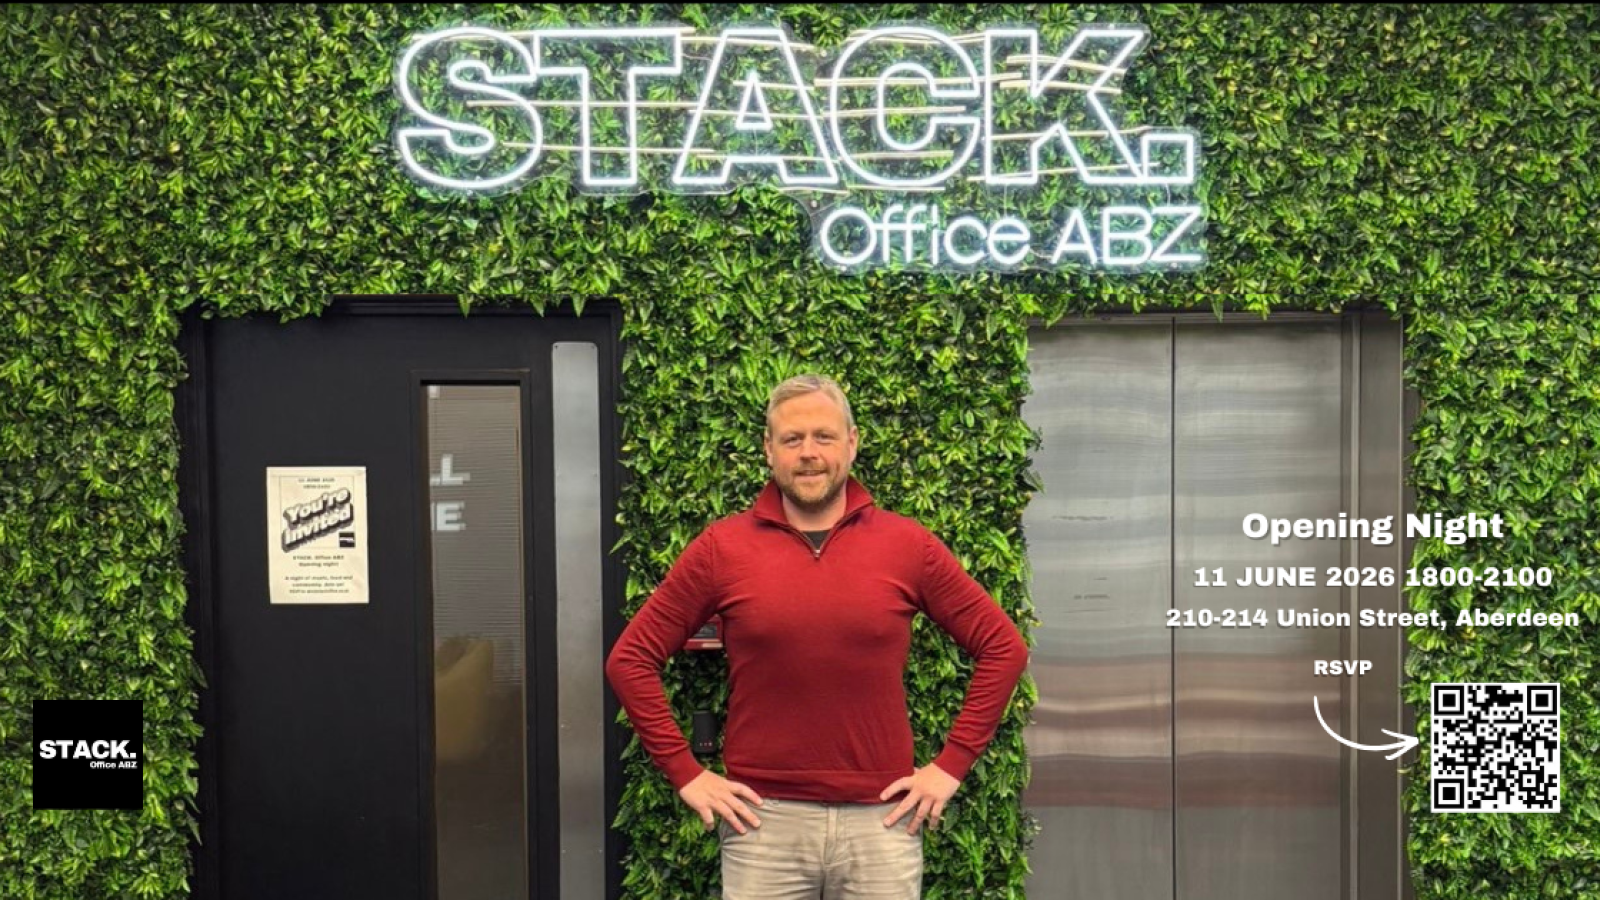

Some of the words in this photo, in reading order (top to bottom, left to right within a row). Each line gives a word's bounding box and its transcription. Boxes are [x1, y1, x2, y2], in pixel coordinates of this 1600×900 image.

[398, 25, 1196, 190] STACK.
[819, 203, 1031, 266] Office
[1051, 204, 1203, 266] ABZ
